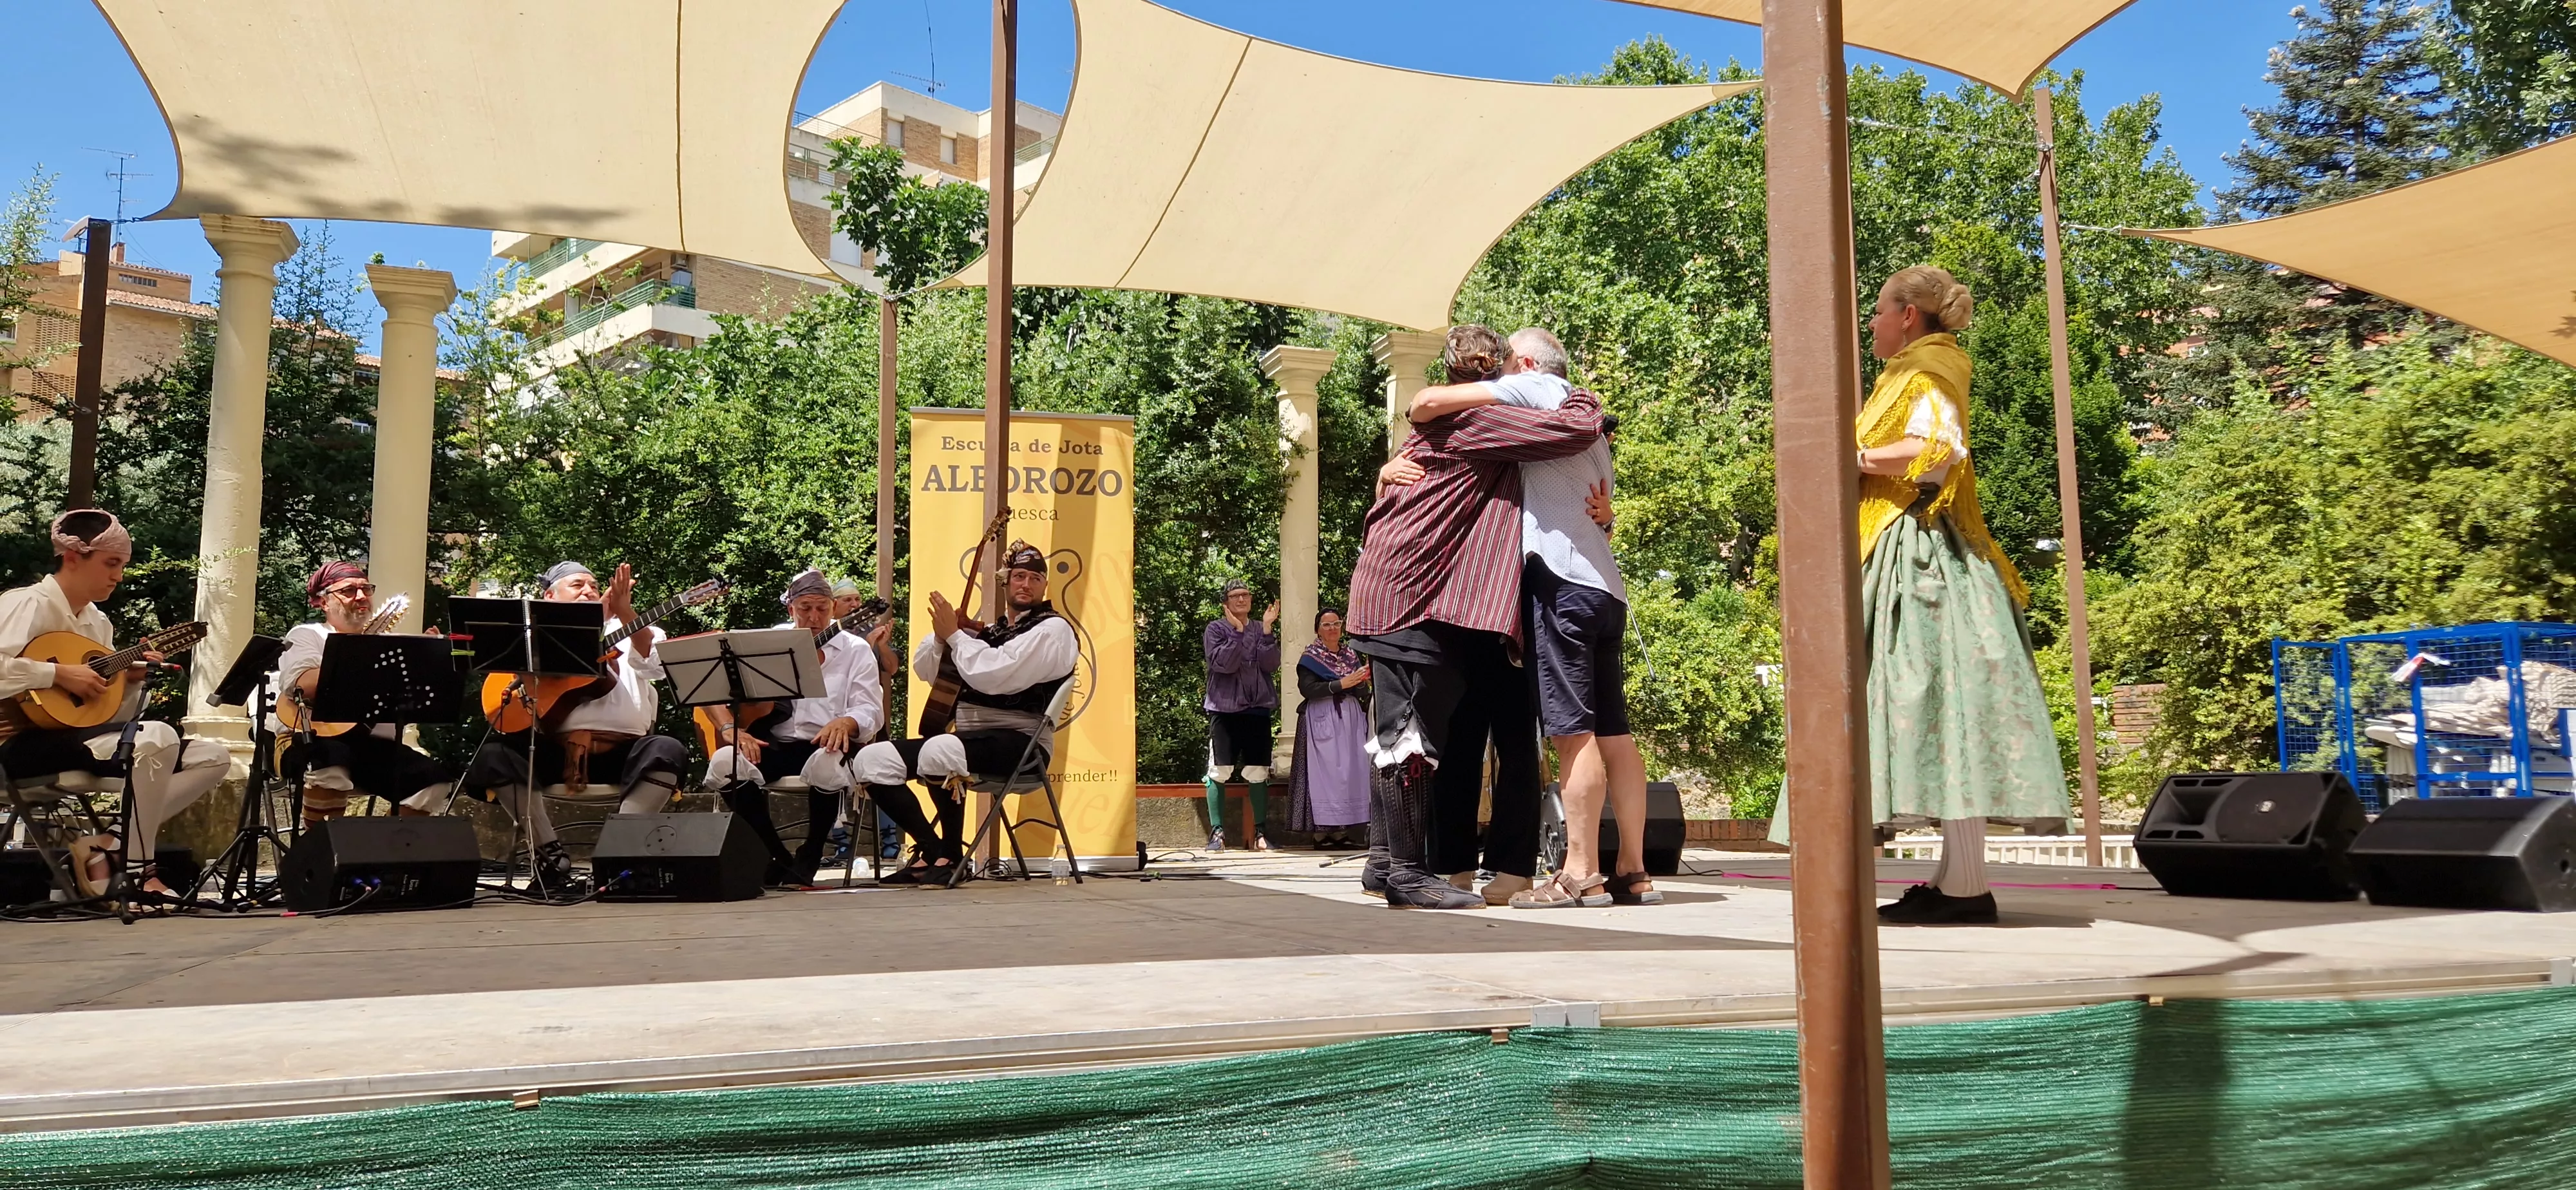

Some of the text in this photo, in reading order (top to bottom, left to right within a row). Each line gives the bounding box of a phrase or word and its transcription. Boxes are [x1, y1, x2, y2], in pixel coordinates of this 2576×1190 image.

[941, 435, 1103, 455] Escua de Jota
[1009, 508, 1060, 520] uesca
[1047, 770, 1117, 784] prender!!
